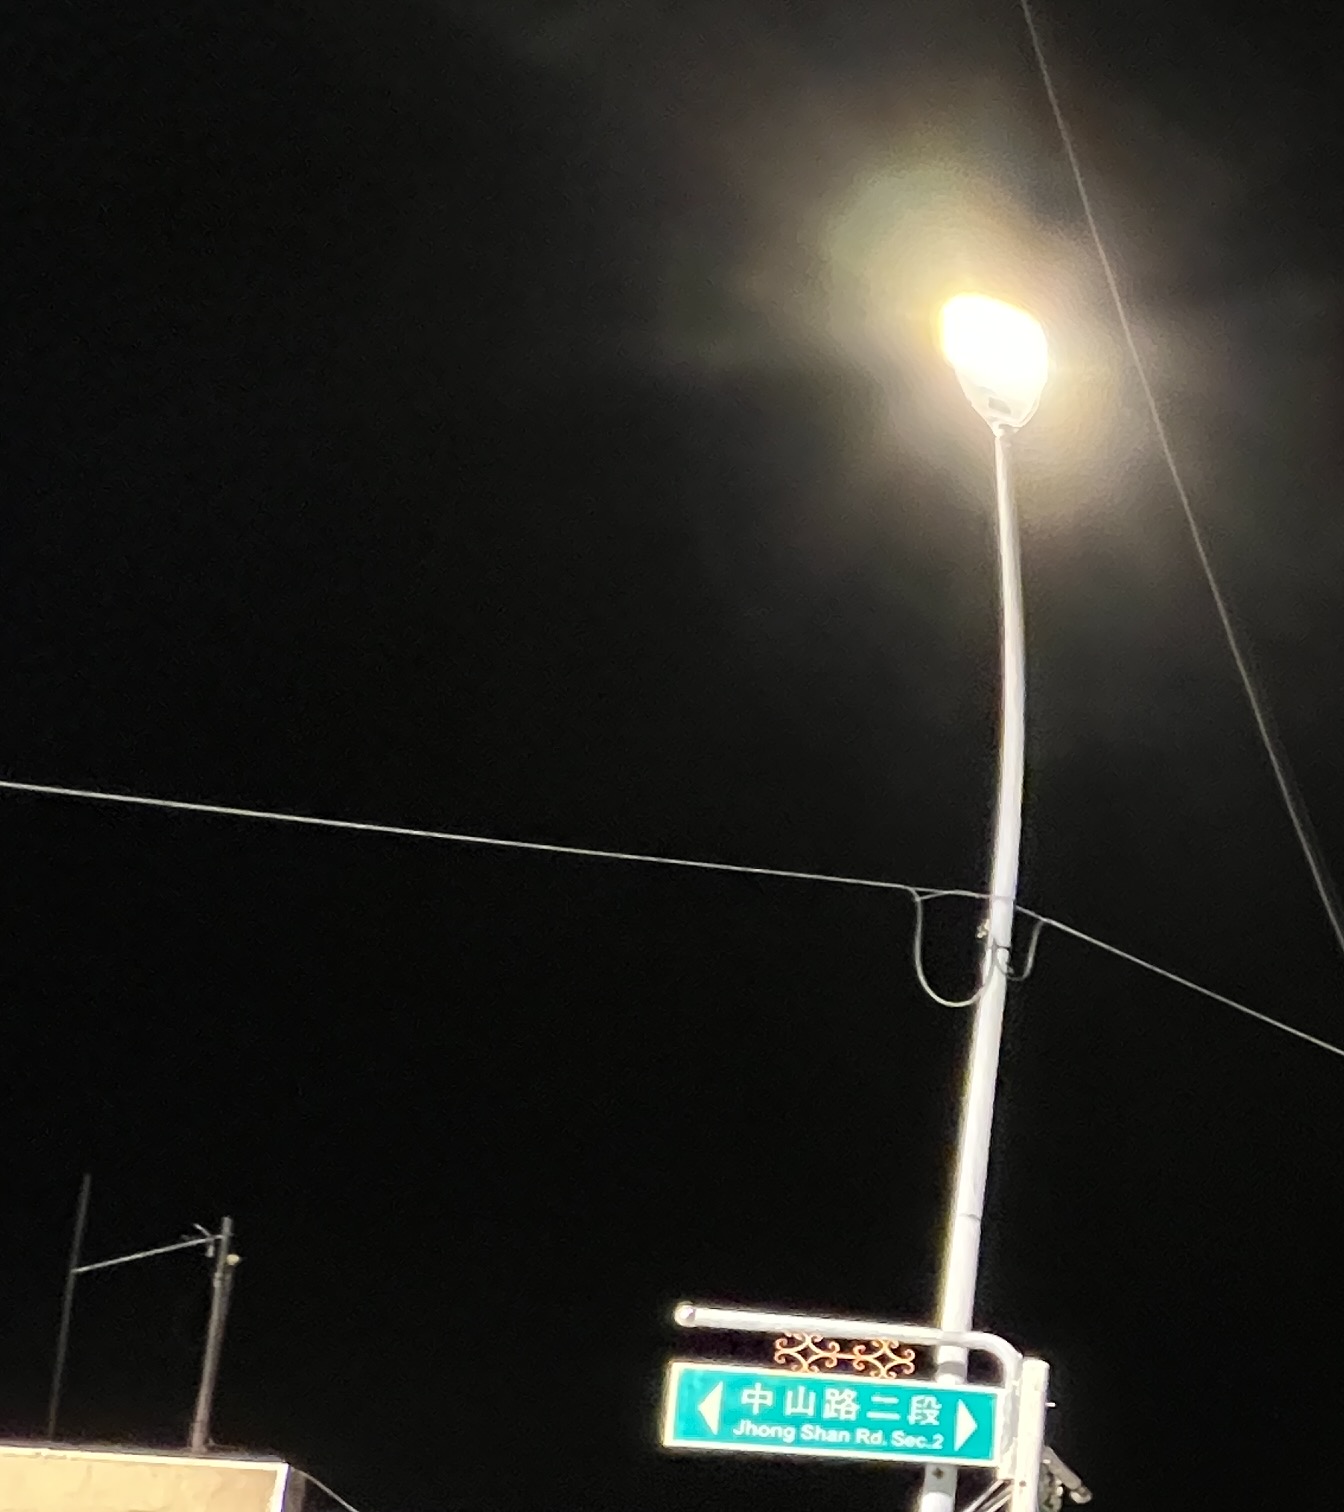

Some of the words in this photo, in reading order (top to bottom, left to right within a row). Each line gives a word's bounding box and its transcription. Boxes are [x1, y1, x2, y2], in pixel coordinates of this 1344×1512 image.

[740, 1382, 942, 1425] 中山路二段
[733, 1419, 796, 1443] Jhong
[800, 1423, 851, 1443] Shan
[856, 1427, 888, 1446] Rd.
